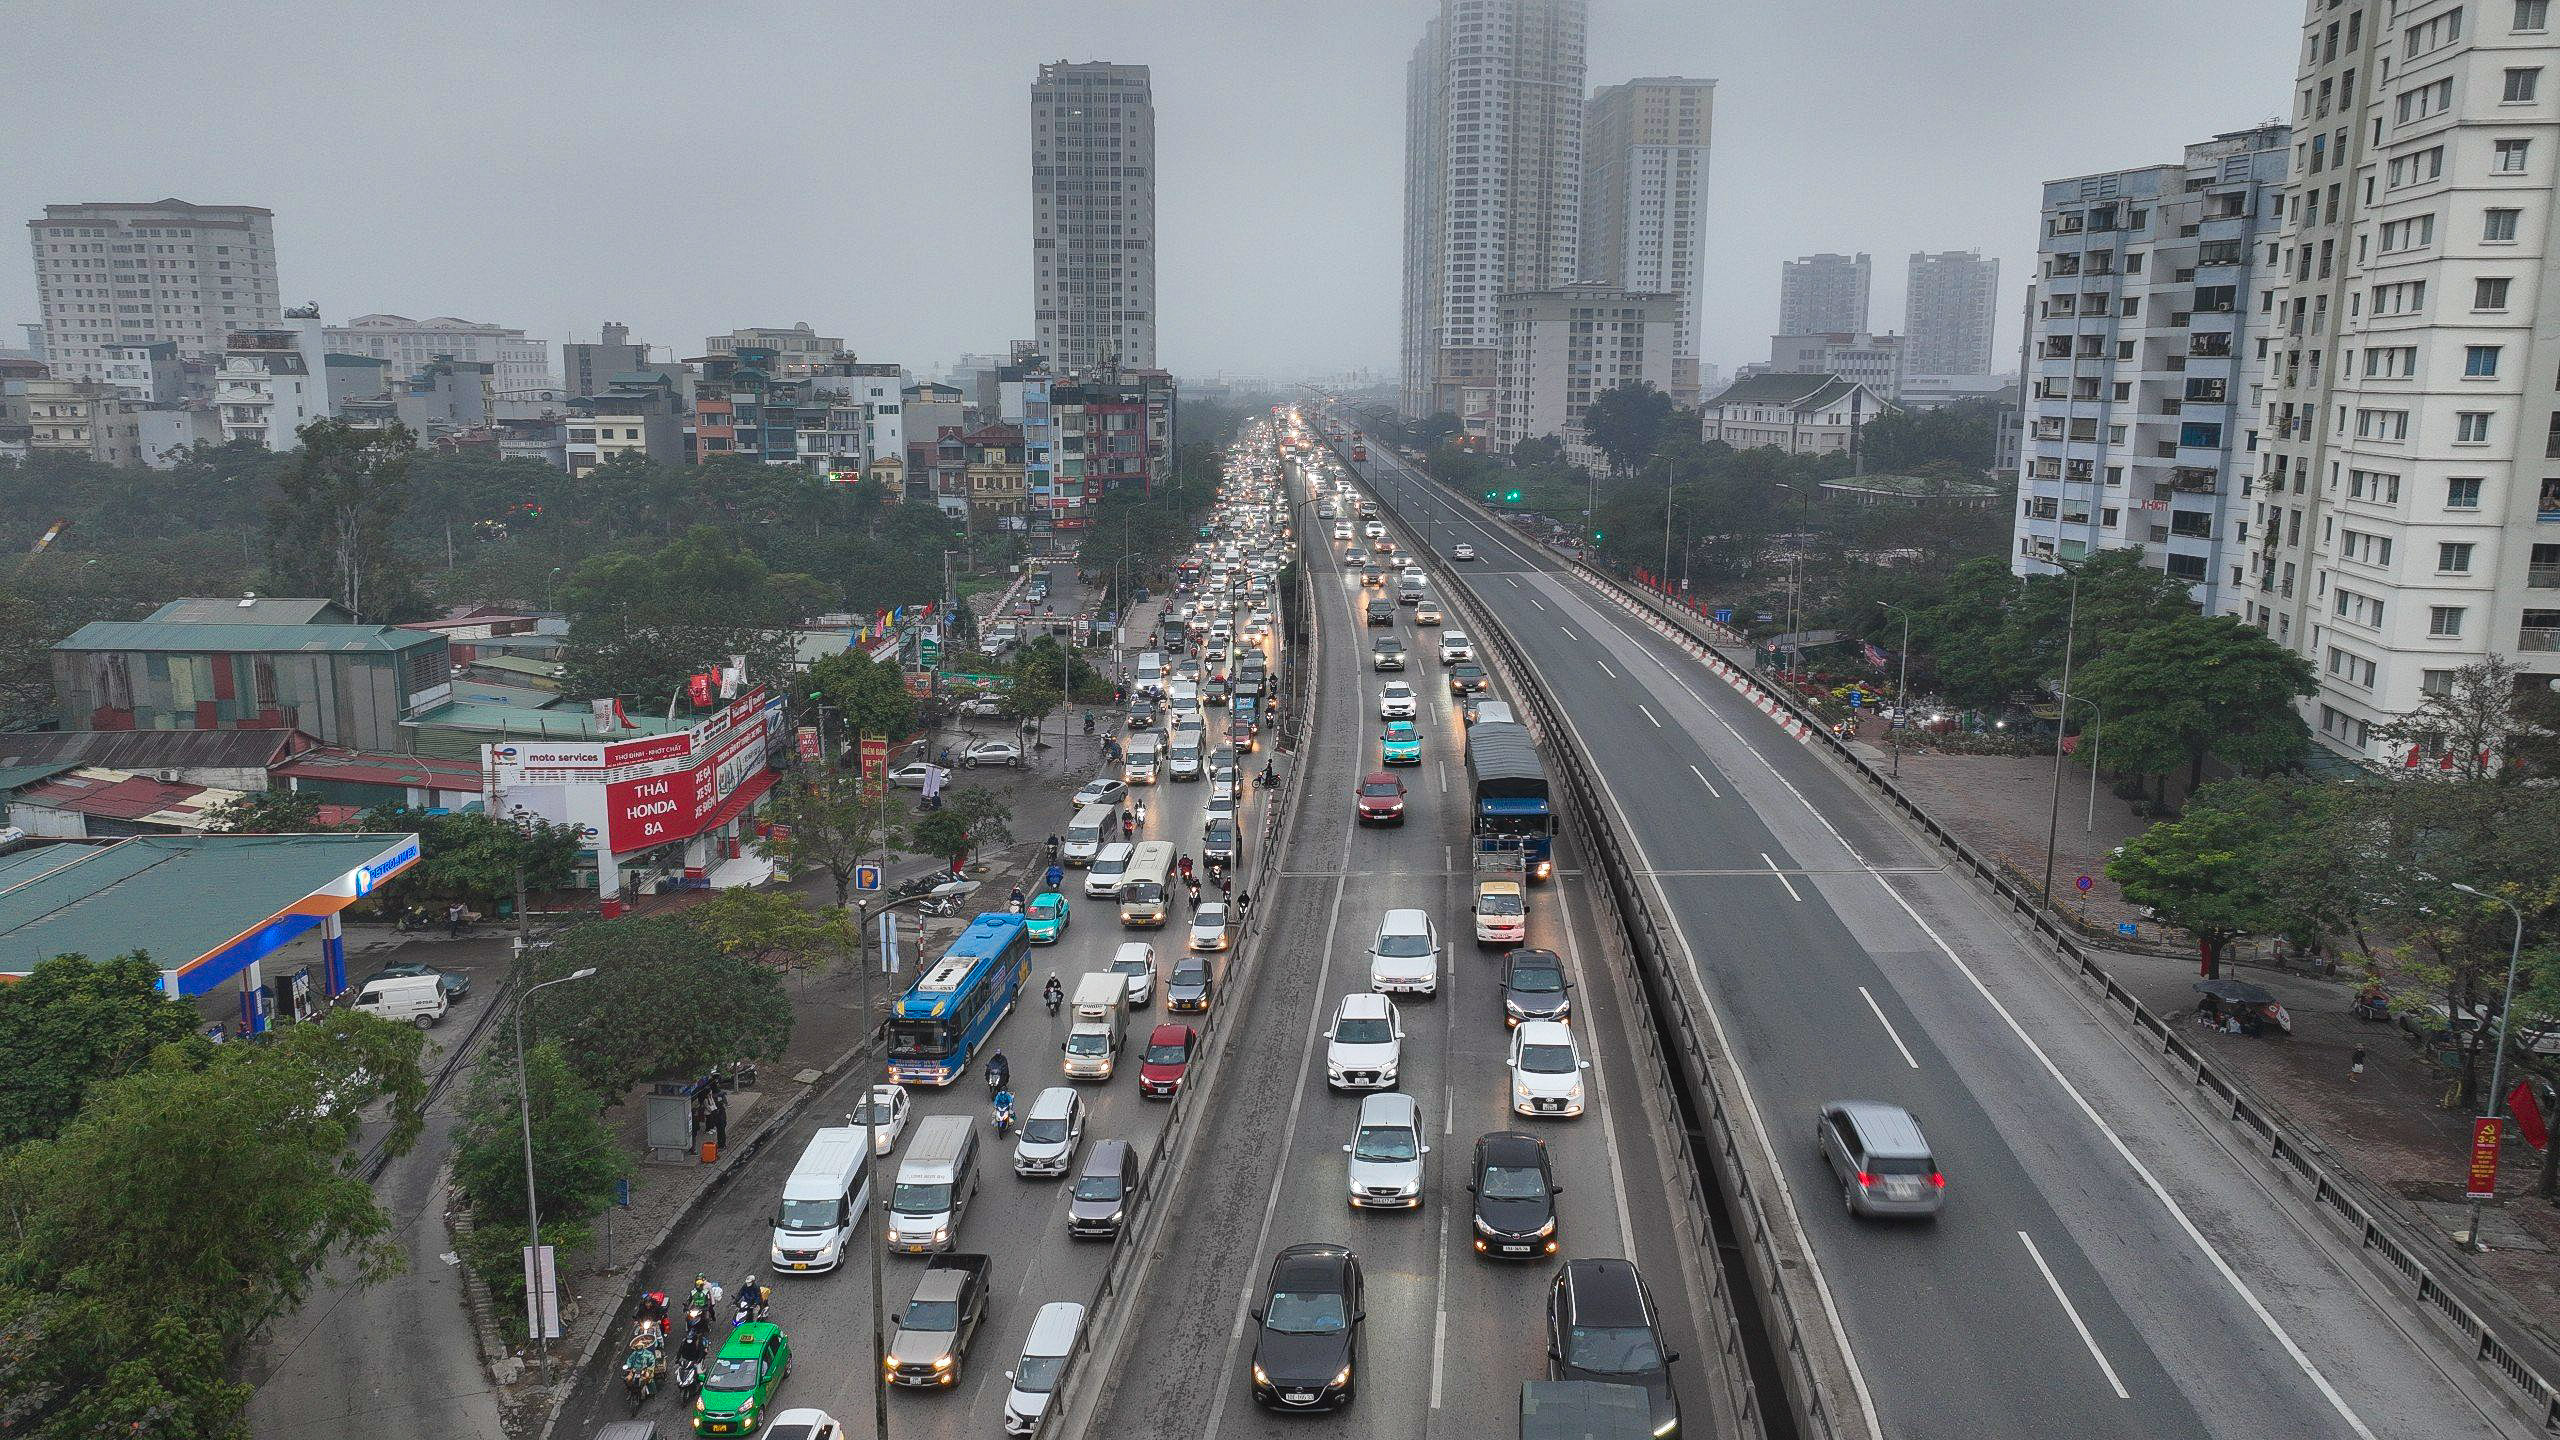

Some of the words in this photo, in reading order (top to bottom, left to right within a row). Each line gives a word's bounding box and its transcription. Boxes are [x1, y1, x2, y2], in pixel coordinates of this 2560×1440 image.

[530, 754, 556, 762] moto
[558, 753, 599, 762] services
[695, 770, 704, 784] XE
[634, 779, 669, 799] THÁI
[696, 786, 704, 801] XE
[626, 799, 678, 820] HONDA
[695, 804, 703, 819] XE
[644, 821, 664, 836] 8A
[2477, 1135, 2497, 1144] 3-2
